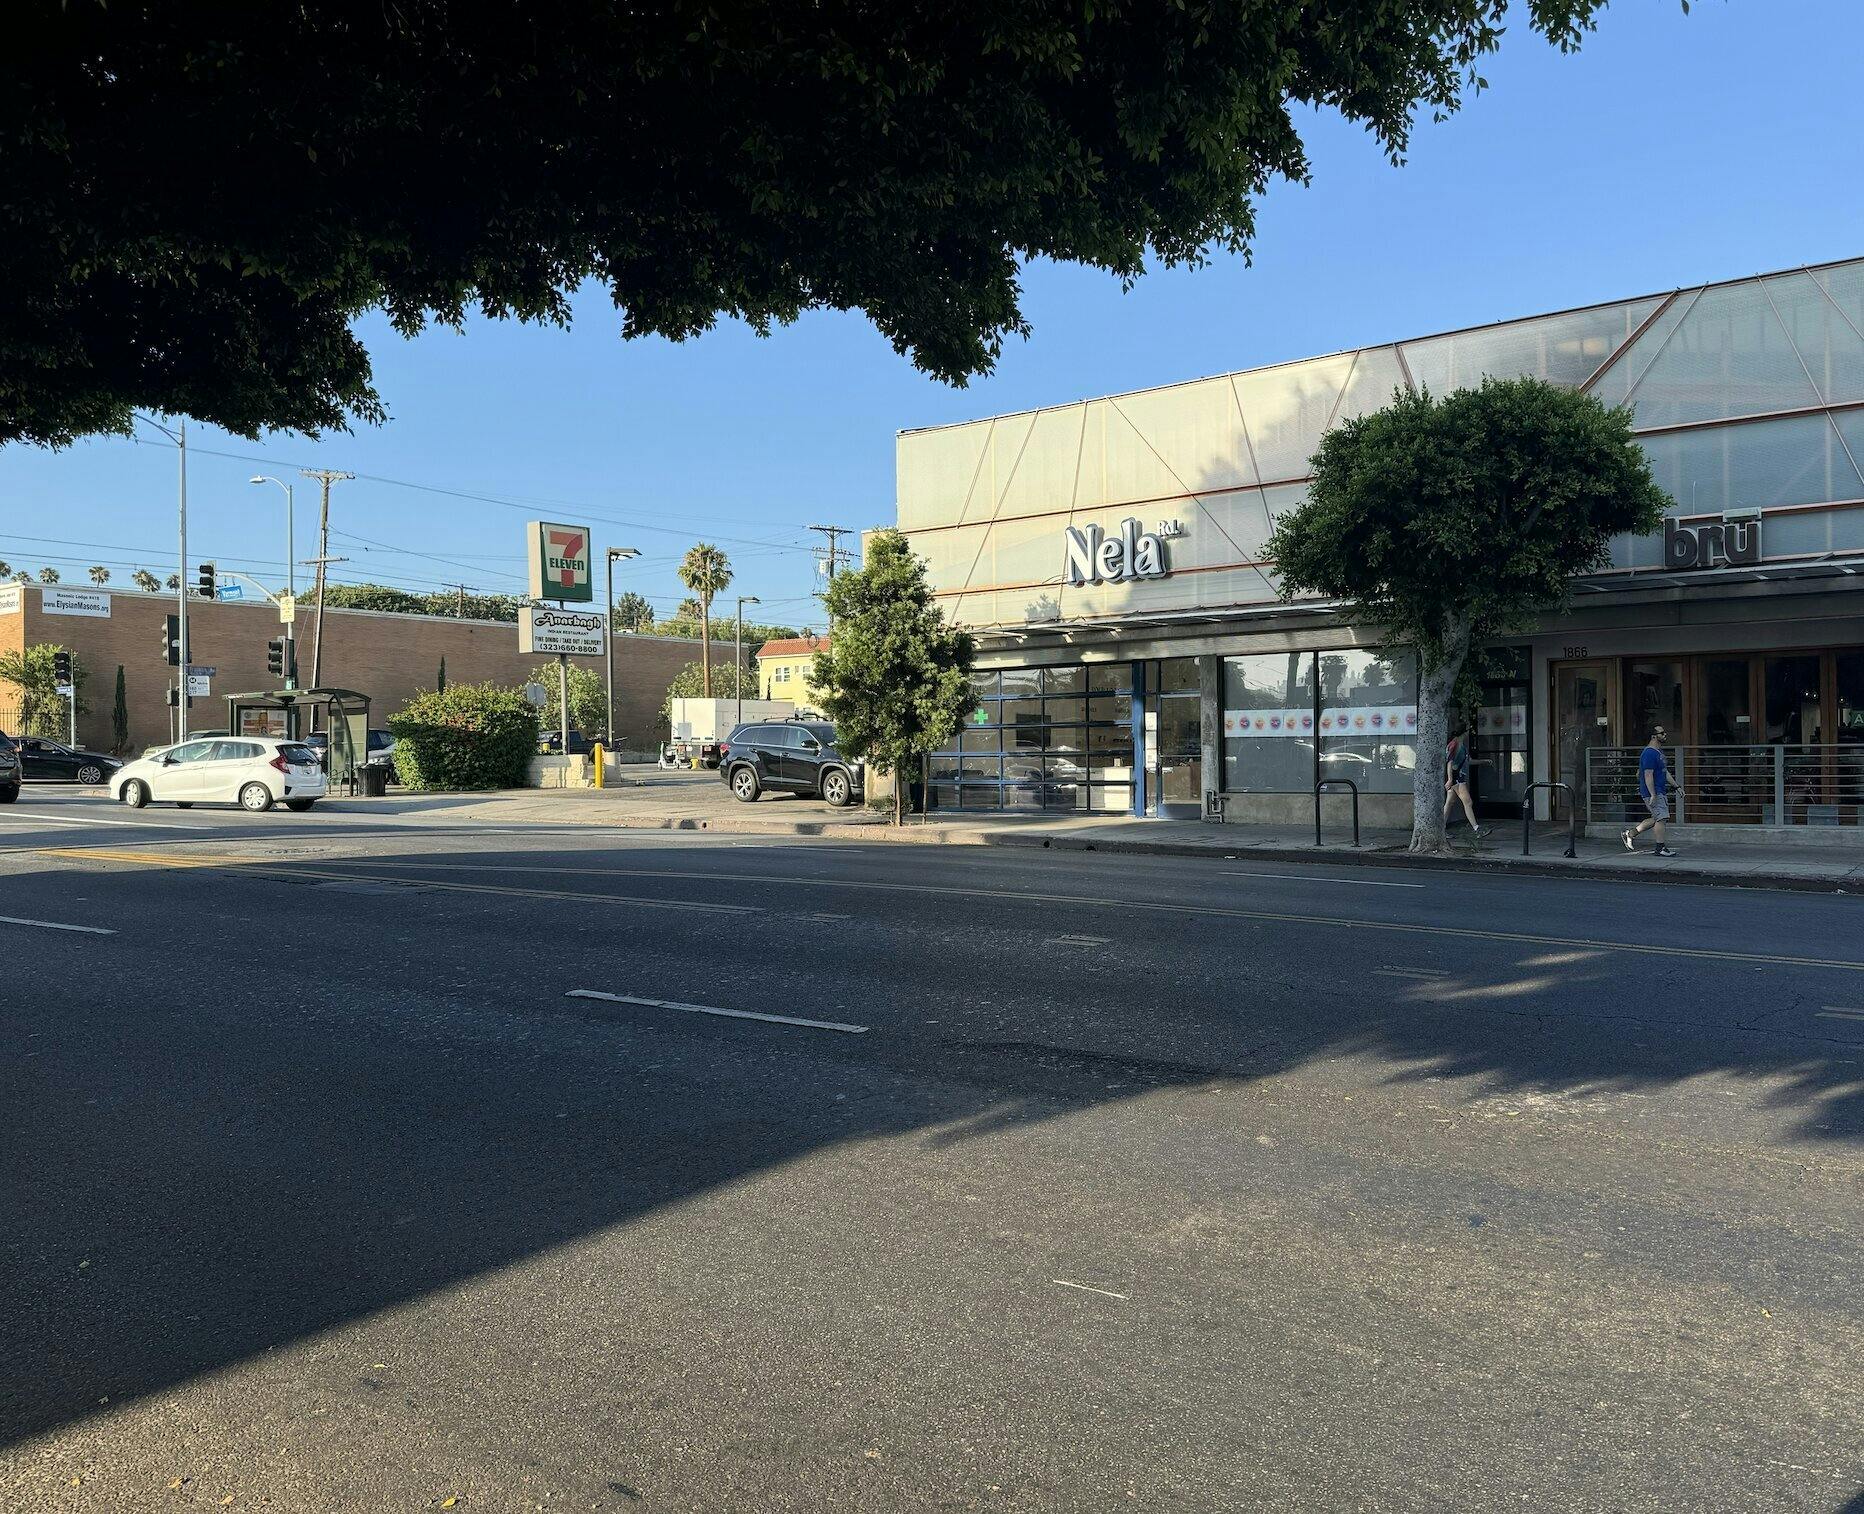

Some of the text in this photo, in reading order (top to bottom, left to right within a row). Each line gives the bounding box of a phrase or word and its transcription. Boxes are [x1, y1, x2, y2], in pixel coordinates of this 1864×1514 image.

[549, 530, 583, 588] 7
[1065, 517, 1167, 586] Nela
[43, 600, 109, 613] www.ElysianMasons.org
[534, 612, 602, 631] Anarbagh
[1562, 647, 1588, 658] 1866
[1854, 714, 1864, 724] A
